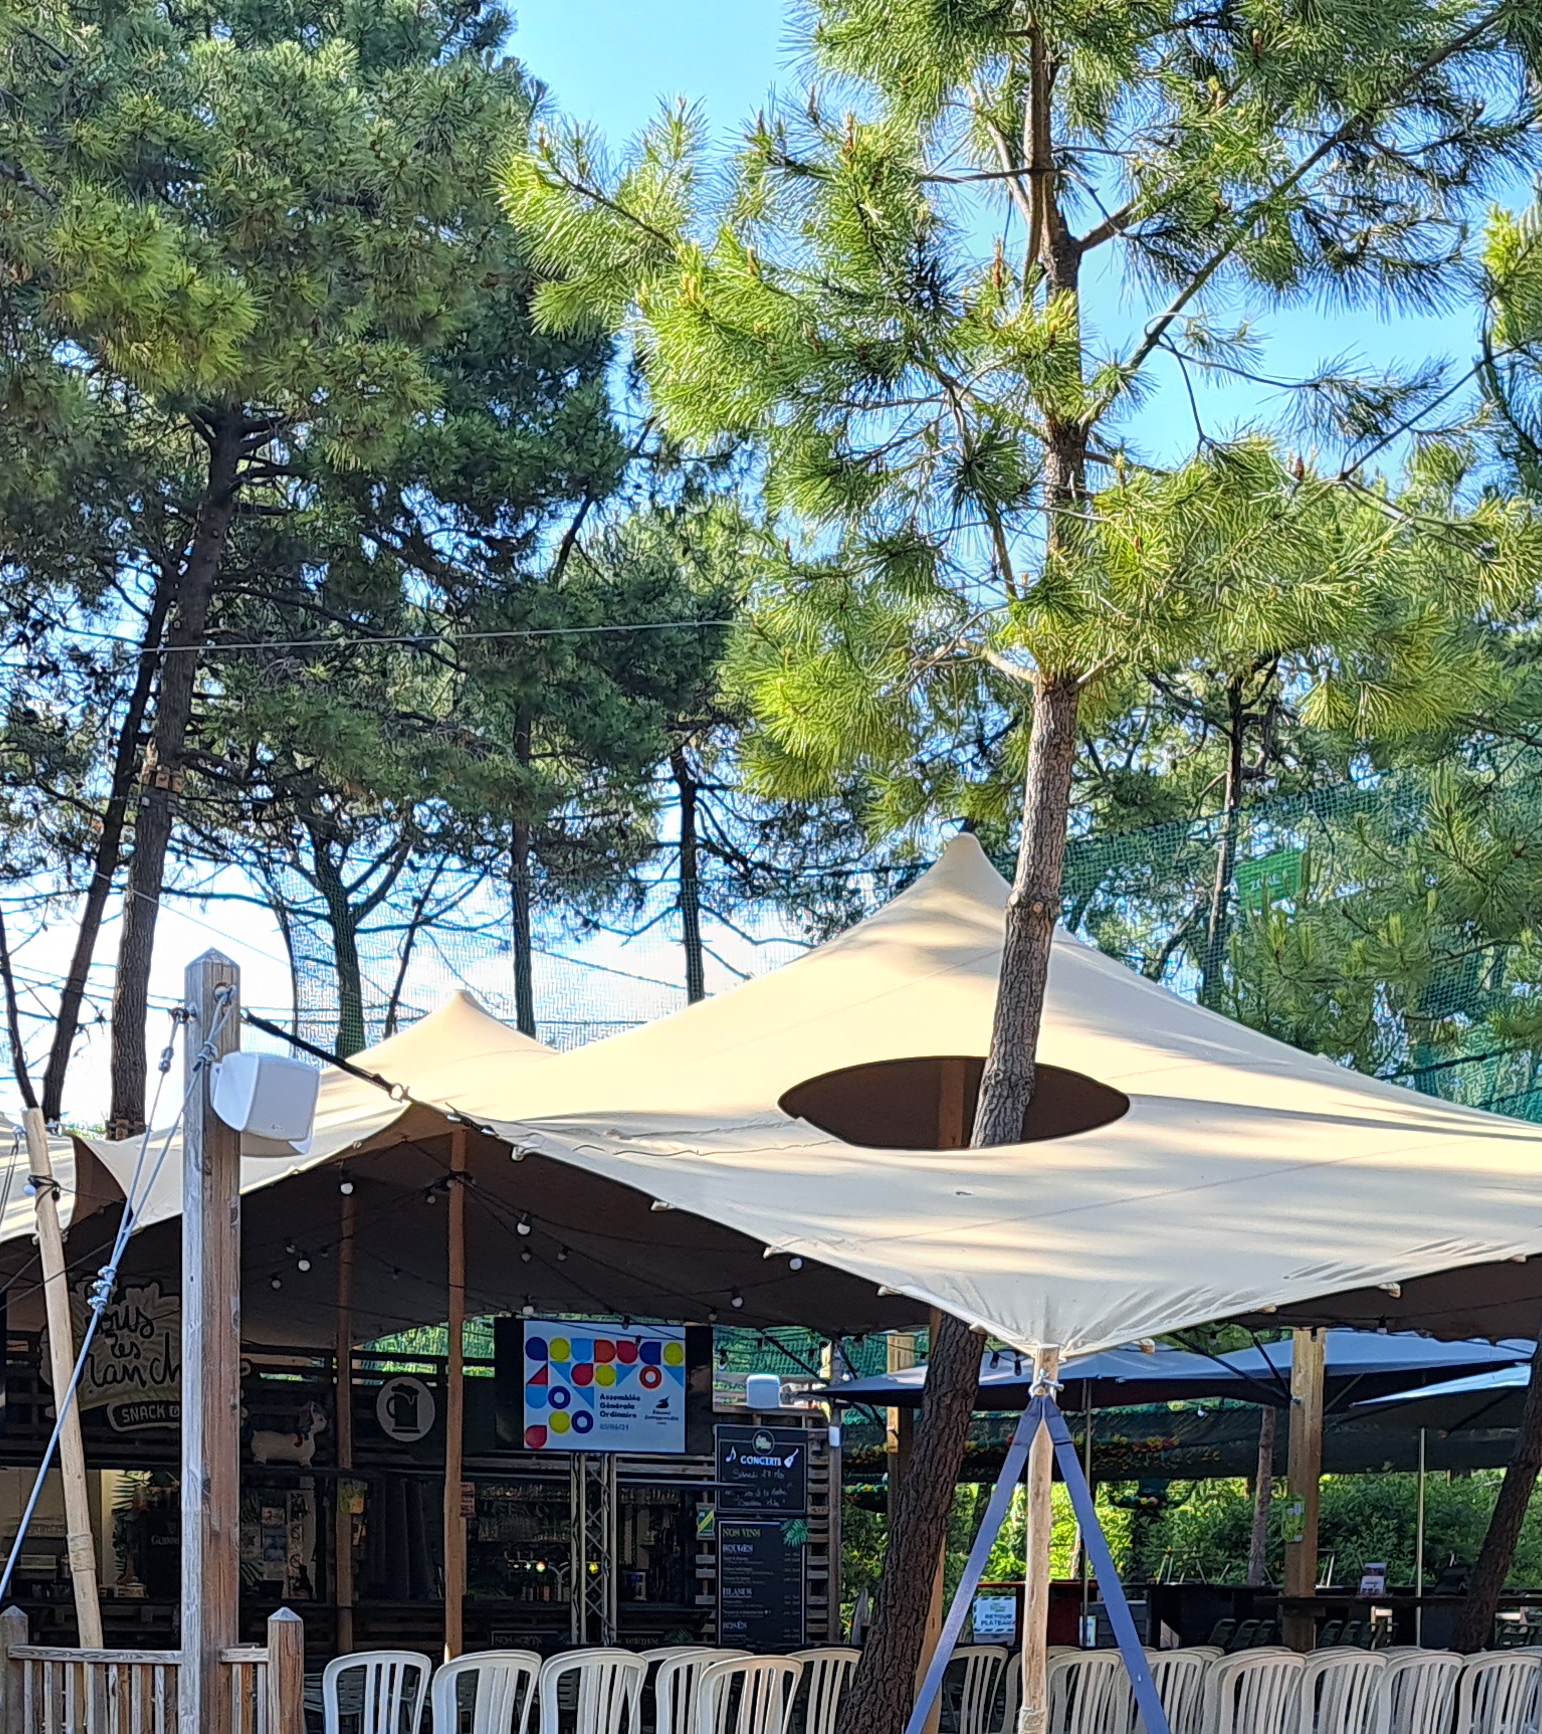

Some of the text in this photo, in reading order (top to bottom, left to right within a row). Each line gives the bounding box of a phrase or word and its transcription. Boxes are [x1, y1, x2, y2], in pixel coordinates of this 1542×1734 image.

[86, 1304, 155, 1339] ous
[599, 1392, 641, 1401] Assemblée
[121, 1405, 166, 1423] SNACK
[599, 1410, 637, 1418] Ordinaire
[740, 1455, 782, 1467] CONCERTS
